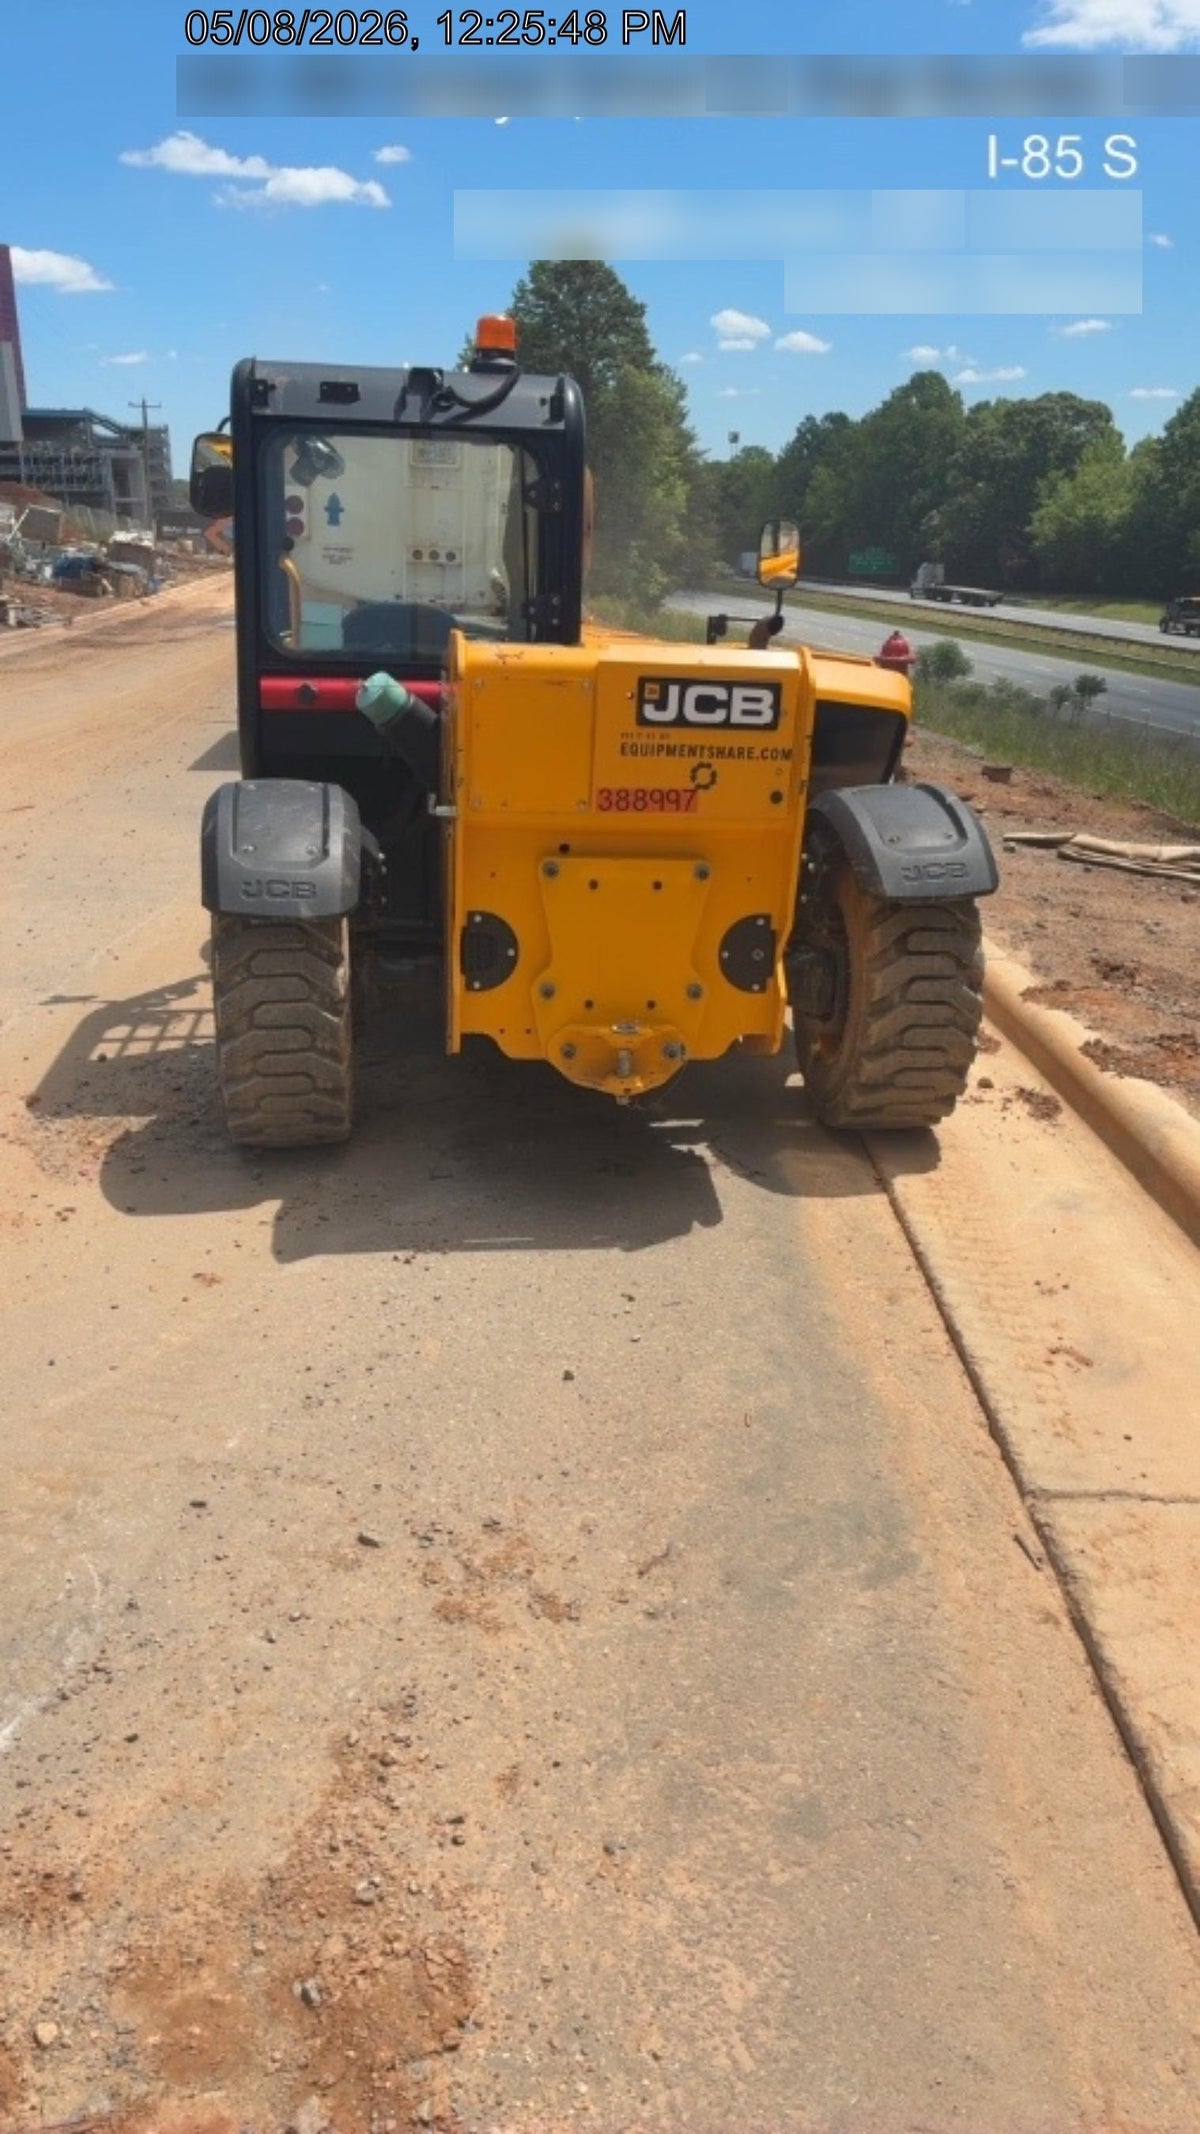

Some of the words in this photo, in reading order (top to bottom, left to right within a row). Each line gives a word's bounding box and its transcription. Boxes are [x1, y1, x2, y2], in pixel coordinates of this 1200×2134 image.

[642, 683, 774, 725] JCB
[620, 741, 793, 761] EQUIPMENTSHARE.COM
[597, 787, 697, 814] 388997
[901, 862, 969, 884] JCB
[240, 878, 316, 901] JCB
